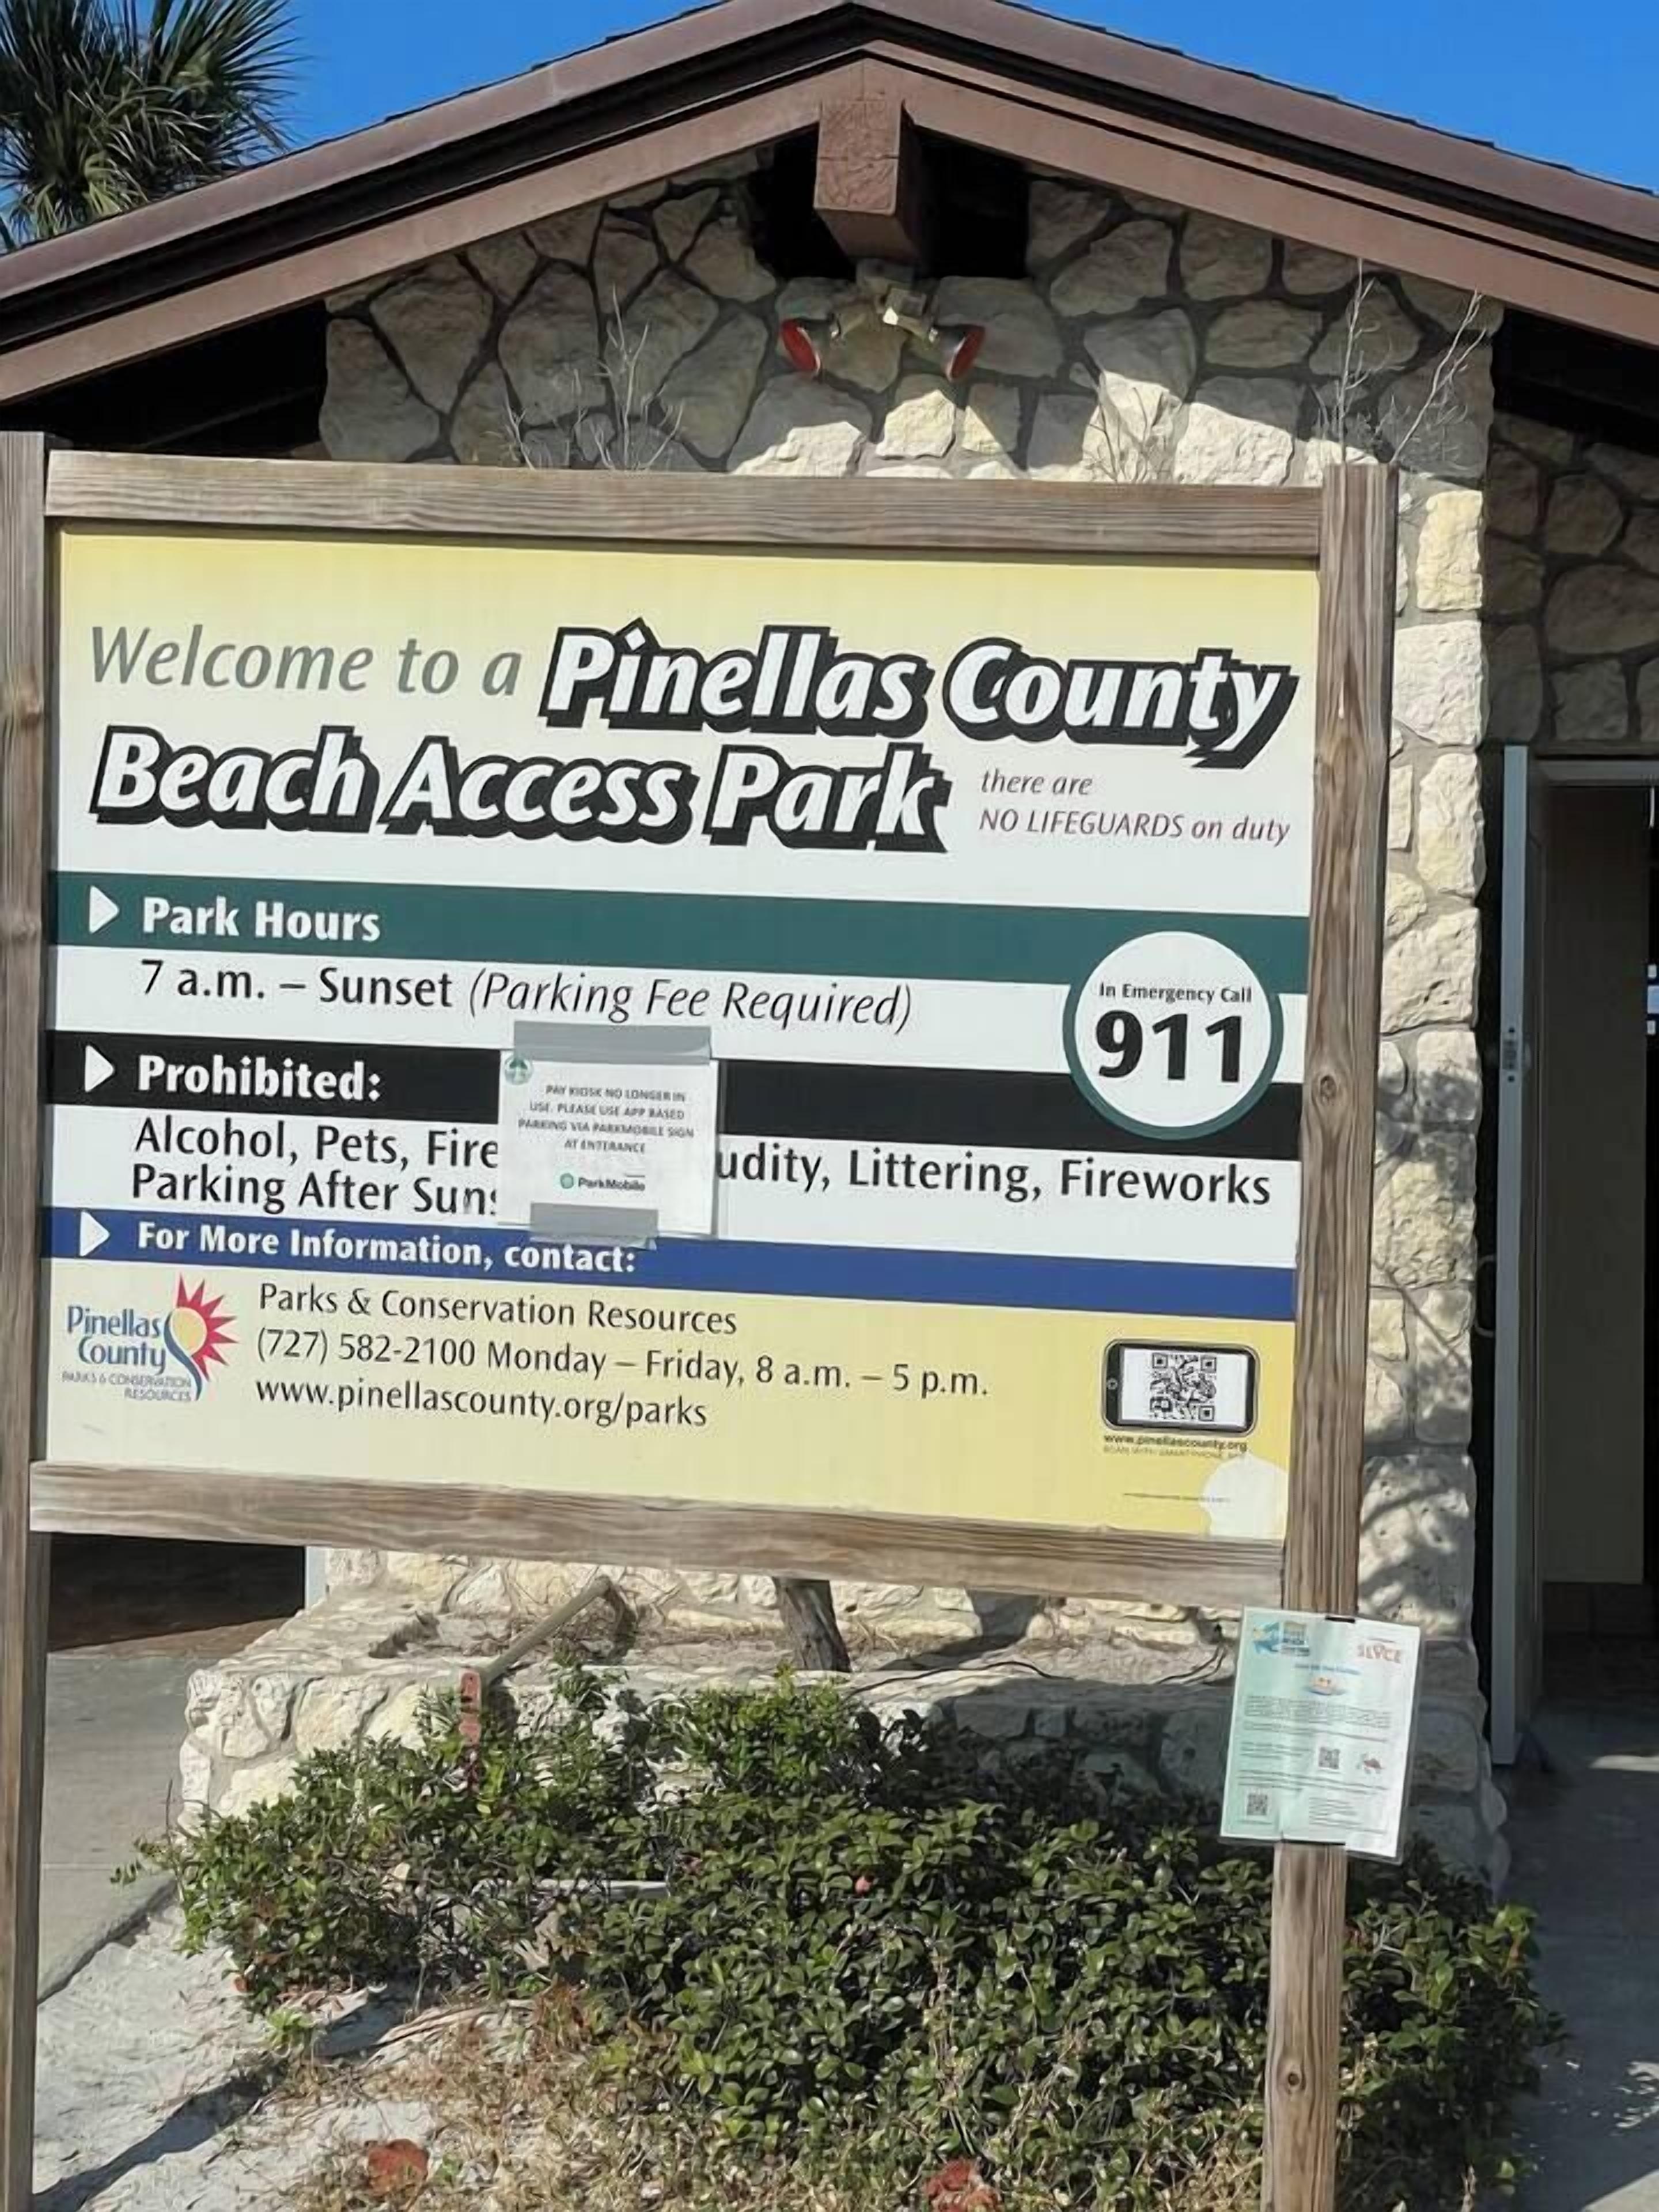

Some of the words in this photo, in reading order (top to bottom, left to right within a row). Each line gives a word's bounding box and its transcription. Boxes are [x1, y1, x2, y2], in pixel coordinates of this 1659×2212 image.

[91, 624, 373, 691] Welcome
[397, 638, 460, 695] to
[482, 650, 522, 696] a
[538, 618, 934, 737] Pinellas
[943, 637, 1300, 768] County
[88, 725, 381, 834] Beach
[376, 736, 700, 846] Access
[703, 743, 953, 853] Park
[980, 768, 1045, 794] there
[1052, 775, 1093, 796] are
[979, 808, 1018, 833] NO
[1026, 809, 1185, 840] LIFEGUARDS
[1190, 820, 1222, 840] on
[1231, 816, 1291, 848] duty
[142, 896, 241, 937] Park
[254, 901, 381, 943] Hours
[141, 959, 165, 995] 7
[176, 968, 266, 999] a.m.
[319, 967, 453, 1007] Sunset
[469, 968, 633, 1024] (Parking
[646, 978, 711, 1016] Fee
[722, 981, 912, 1035] Required)
[1099, 982, 1116, 997] In
[1122, 983, 1215, 1005] Emergency
[1220, 986, 1252, 1003] Call
[1096, 1009, 1243, 1083] 911
[137, 1054, 382, 1103] Prohibited:
[546, 1084, 567, 1096] PAY
[569, 1086, 603, 1099] KIOSK
[605, 1088, 623, 1100] NO
[626, 1089, 672, 1102] LONGER
[672, 1092, 685, 1103] IN
[518, 1119, 567, 1131] PARKING
[570, 1121, 590, 1132] VIA
[592, 1123, 664, 1137] PARKMOBILE
[668, 1126, 694, 1138] SIGN
[557, 1103, 596, 1115] PLEASE
[599, 1105, 620, 1117] USE
[624, 1107, 646, 1118] APP
[649, 1107, 685, 1120] BASED
[135, 1114, 298, 1166] Alcohol,
[316, 1124, 408, 1171] Pets,
[427, 1128, 499, 1169] Fire
[715, 1143, 831, 1193] udity,
[849, 1146, 1041, 1203] Littering,
[1060, 1156, 1271, 1206] Fireworks
[564, 1138, 578, 1150] AT
[132, 1163, 286, 1214] Parking
[298, 1169, 399, 1211] After
[412, 1177, 498, 1217] Sun
[578, 1176, 646, 1192] ParkMobile
[138, 1221, 190, 1252] For
[199, 1224, 280, 1255] More
[290, 1229, 493, 1272] Information,
[504, 1243, 635, 1273] contact:
[67, 1305, 162, 1338] Pinellas
[260, 1282, 338, 1314] Parks
[347, 1289, 371, 1316] &
[381, 1289, 575, 1327] Conservation
[588, 1301, 737, 1335] Resources
[78, 1336, 166, 1376] County
[256, 1328, 328, 1365] (727)
[338, 1333, 475, 1366] 582-2100
[487, 1340, 607, 1380] Monday
[645, 1350, 745, 1389] Friday,
[755, 1355, 774, 1383] 8
[784, 1363, 851, 1388] a.m.
[892, 1363, 910, 1392] 5
[920, 1369, 988, 1400] p.m.
[256, 1377, 707, 1428] www.pinellascounty.org/parks
[1103, 1434, 1248, 1453] www.pinellascounty.org
